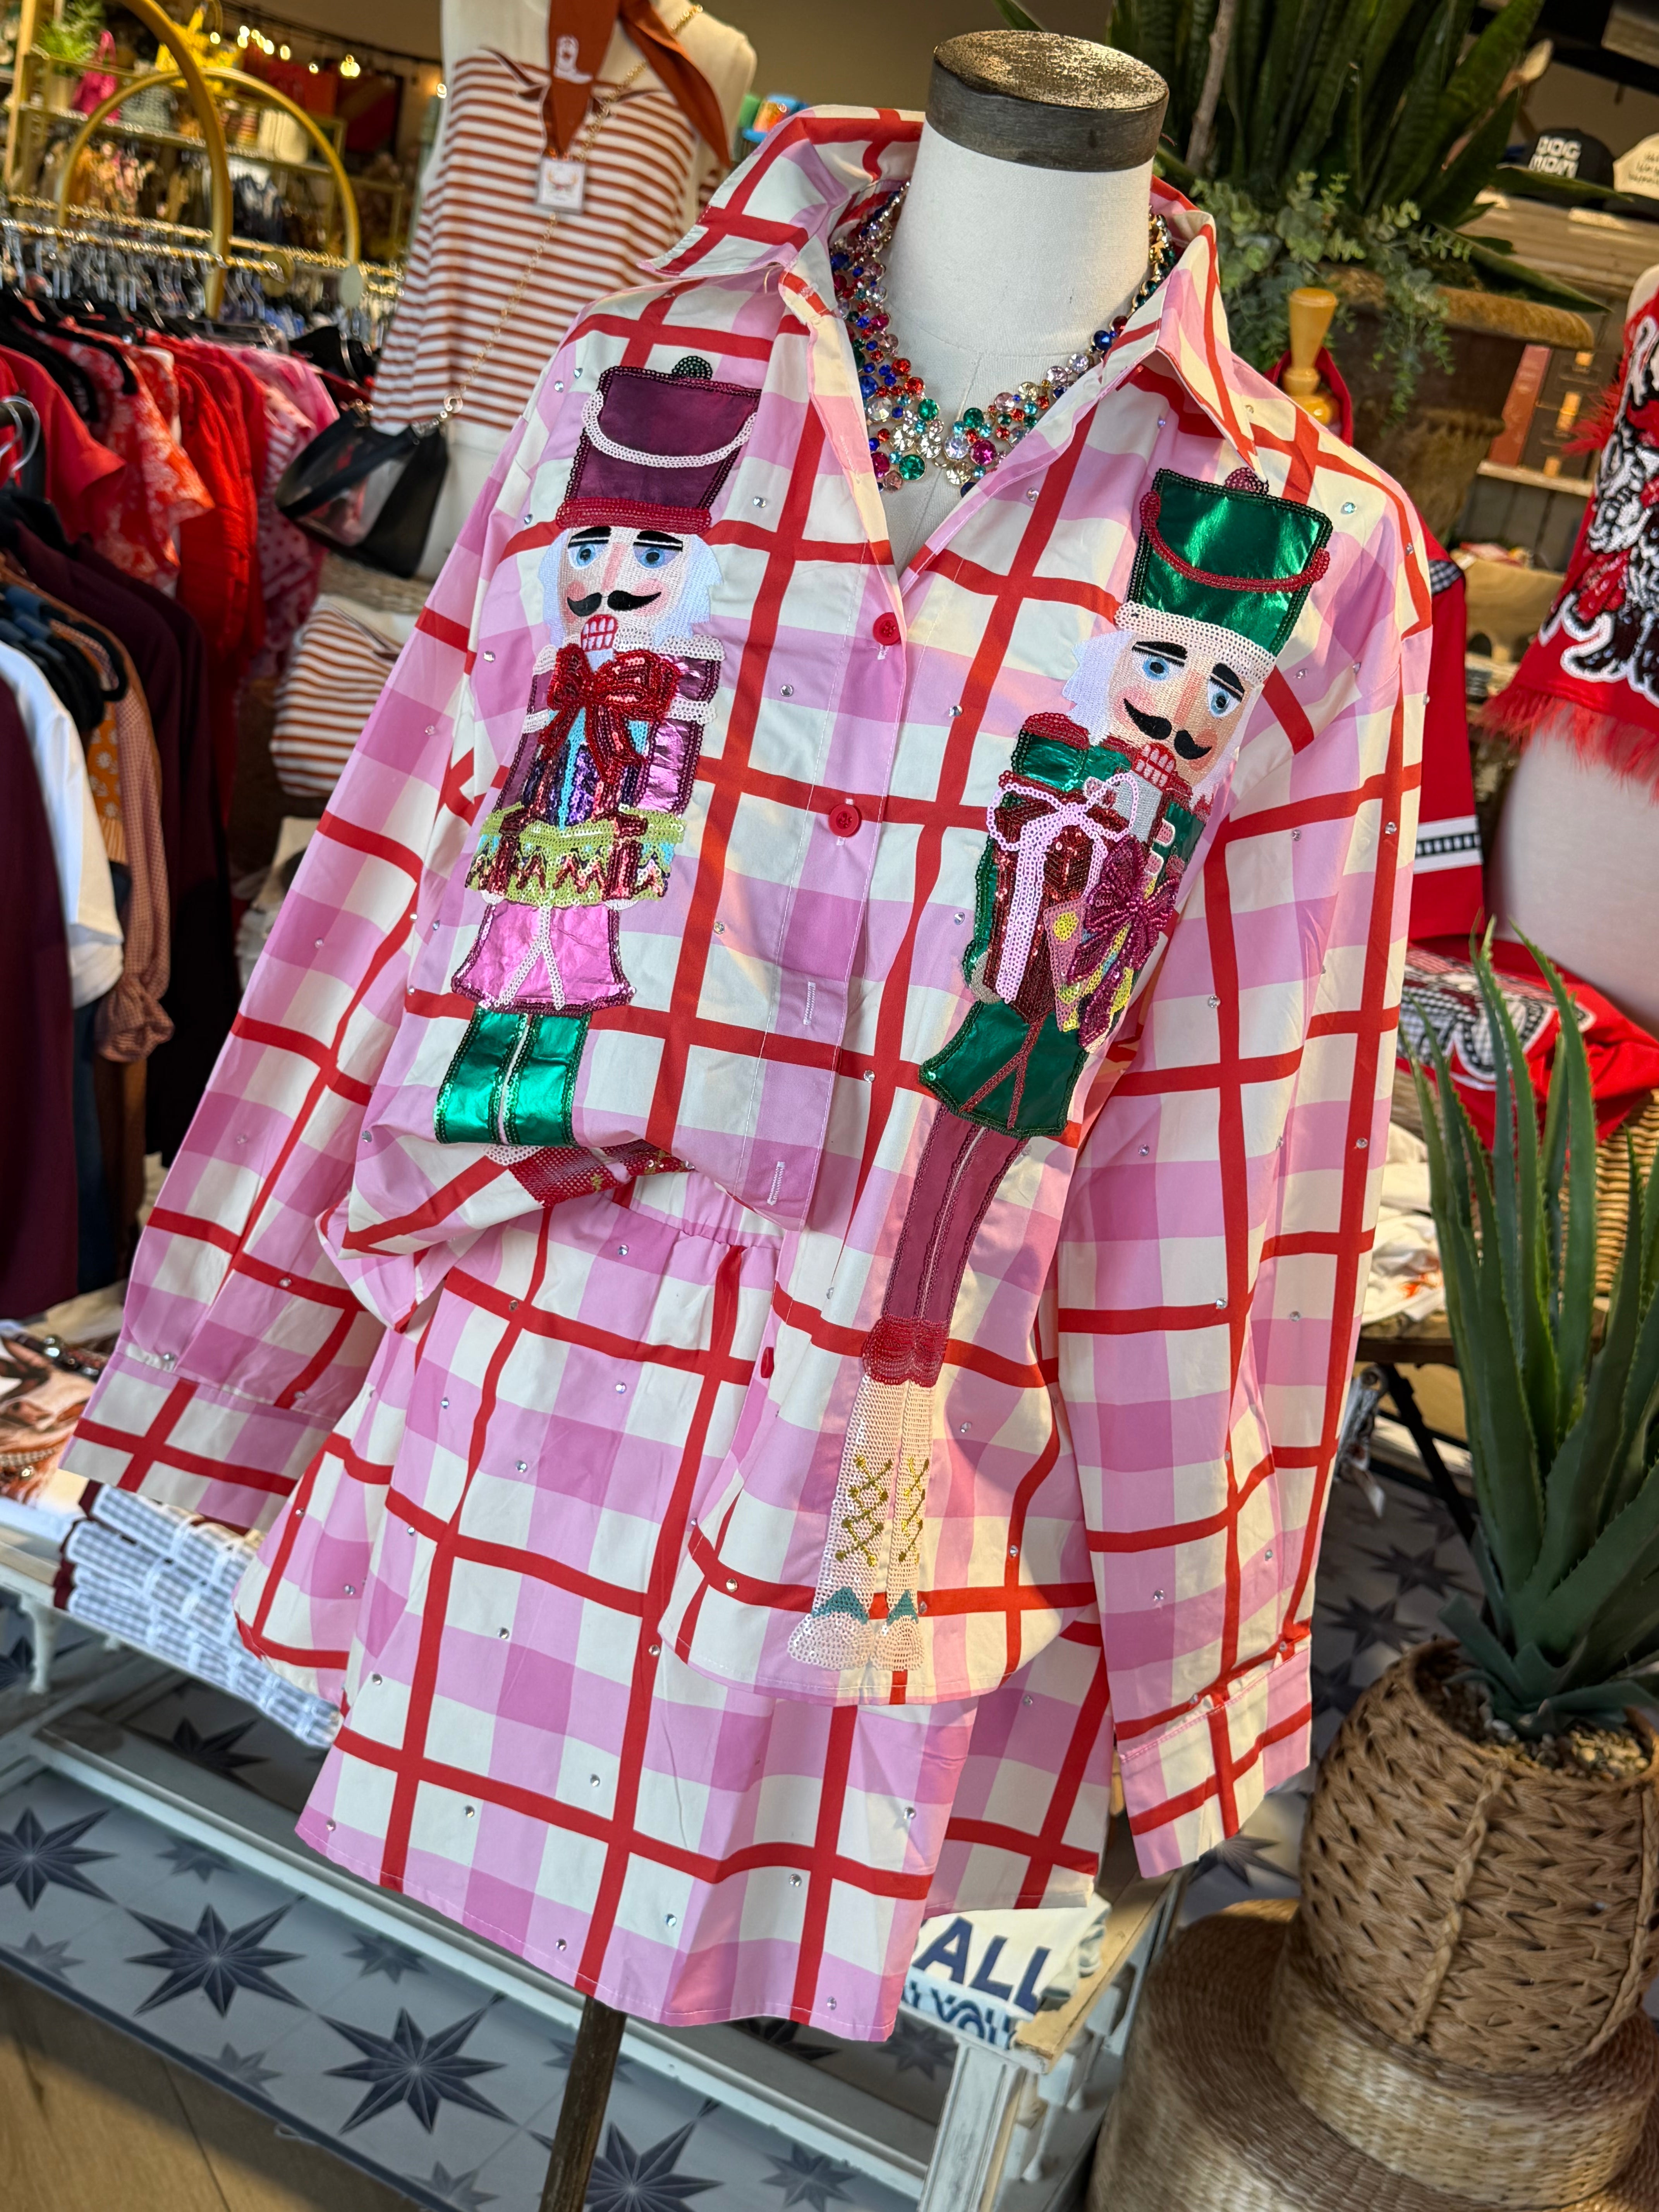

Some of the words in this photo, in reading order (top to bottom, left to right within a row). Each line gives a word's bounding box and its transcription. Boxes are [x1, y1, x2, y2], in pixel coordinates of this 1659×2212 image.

[1535, 135, 1582, 161] DOG
[1528, 154, 1579, 179] MOM
[912, 1915, 1052, 2015] ALL
